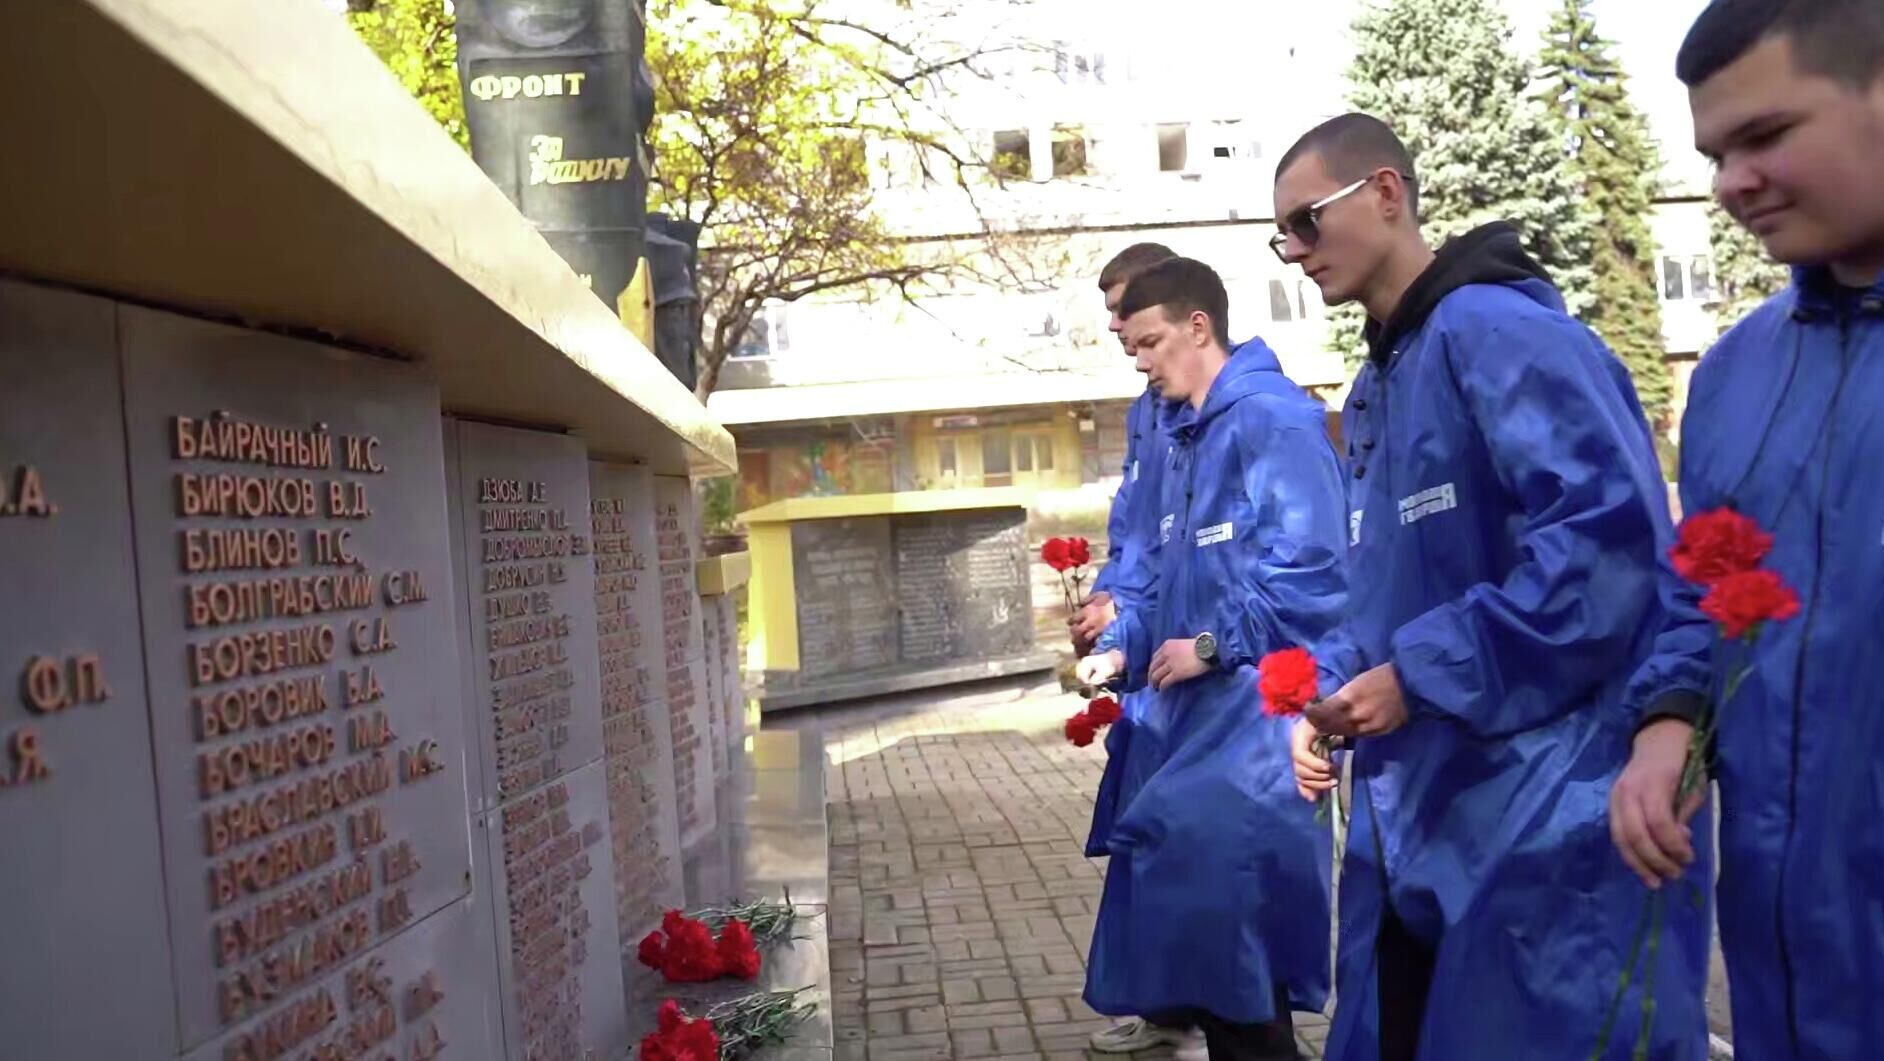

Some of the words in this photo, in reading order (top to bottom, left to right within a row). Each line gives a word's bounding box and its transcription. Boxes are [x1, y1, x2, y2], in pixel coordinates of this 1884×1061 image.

[470, 72, 585, 100] ФРОНТ
[176, 409, 333, 467] БАЙРАЧНЫЙ
[347, 436, 388, 473] И.С.
[181, 475, 315, 516] БИРЮКОВ
[330, 481, 374, 518] В.Д.
[185, 529, 300, 570] БЛИНОВ
[314, 528, 363, 567] П.С.
[191, 568, 374, 626] БОЛГРАБСКИЙ
[197, 624, 336, 682] БОРЗЕНКО
[199, 675, 327, 738] БОРОВИК
[203, 725, 336, 795] БОЧАРОВ
